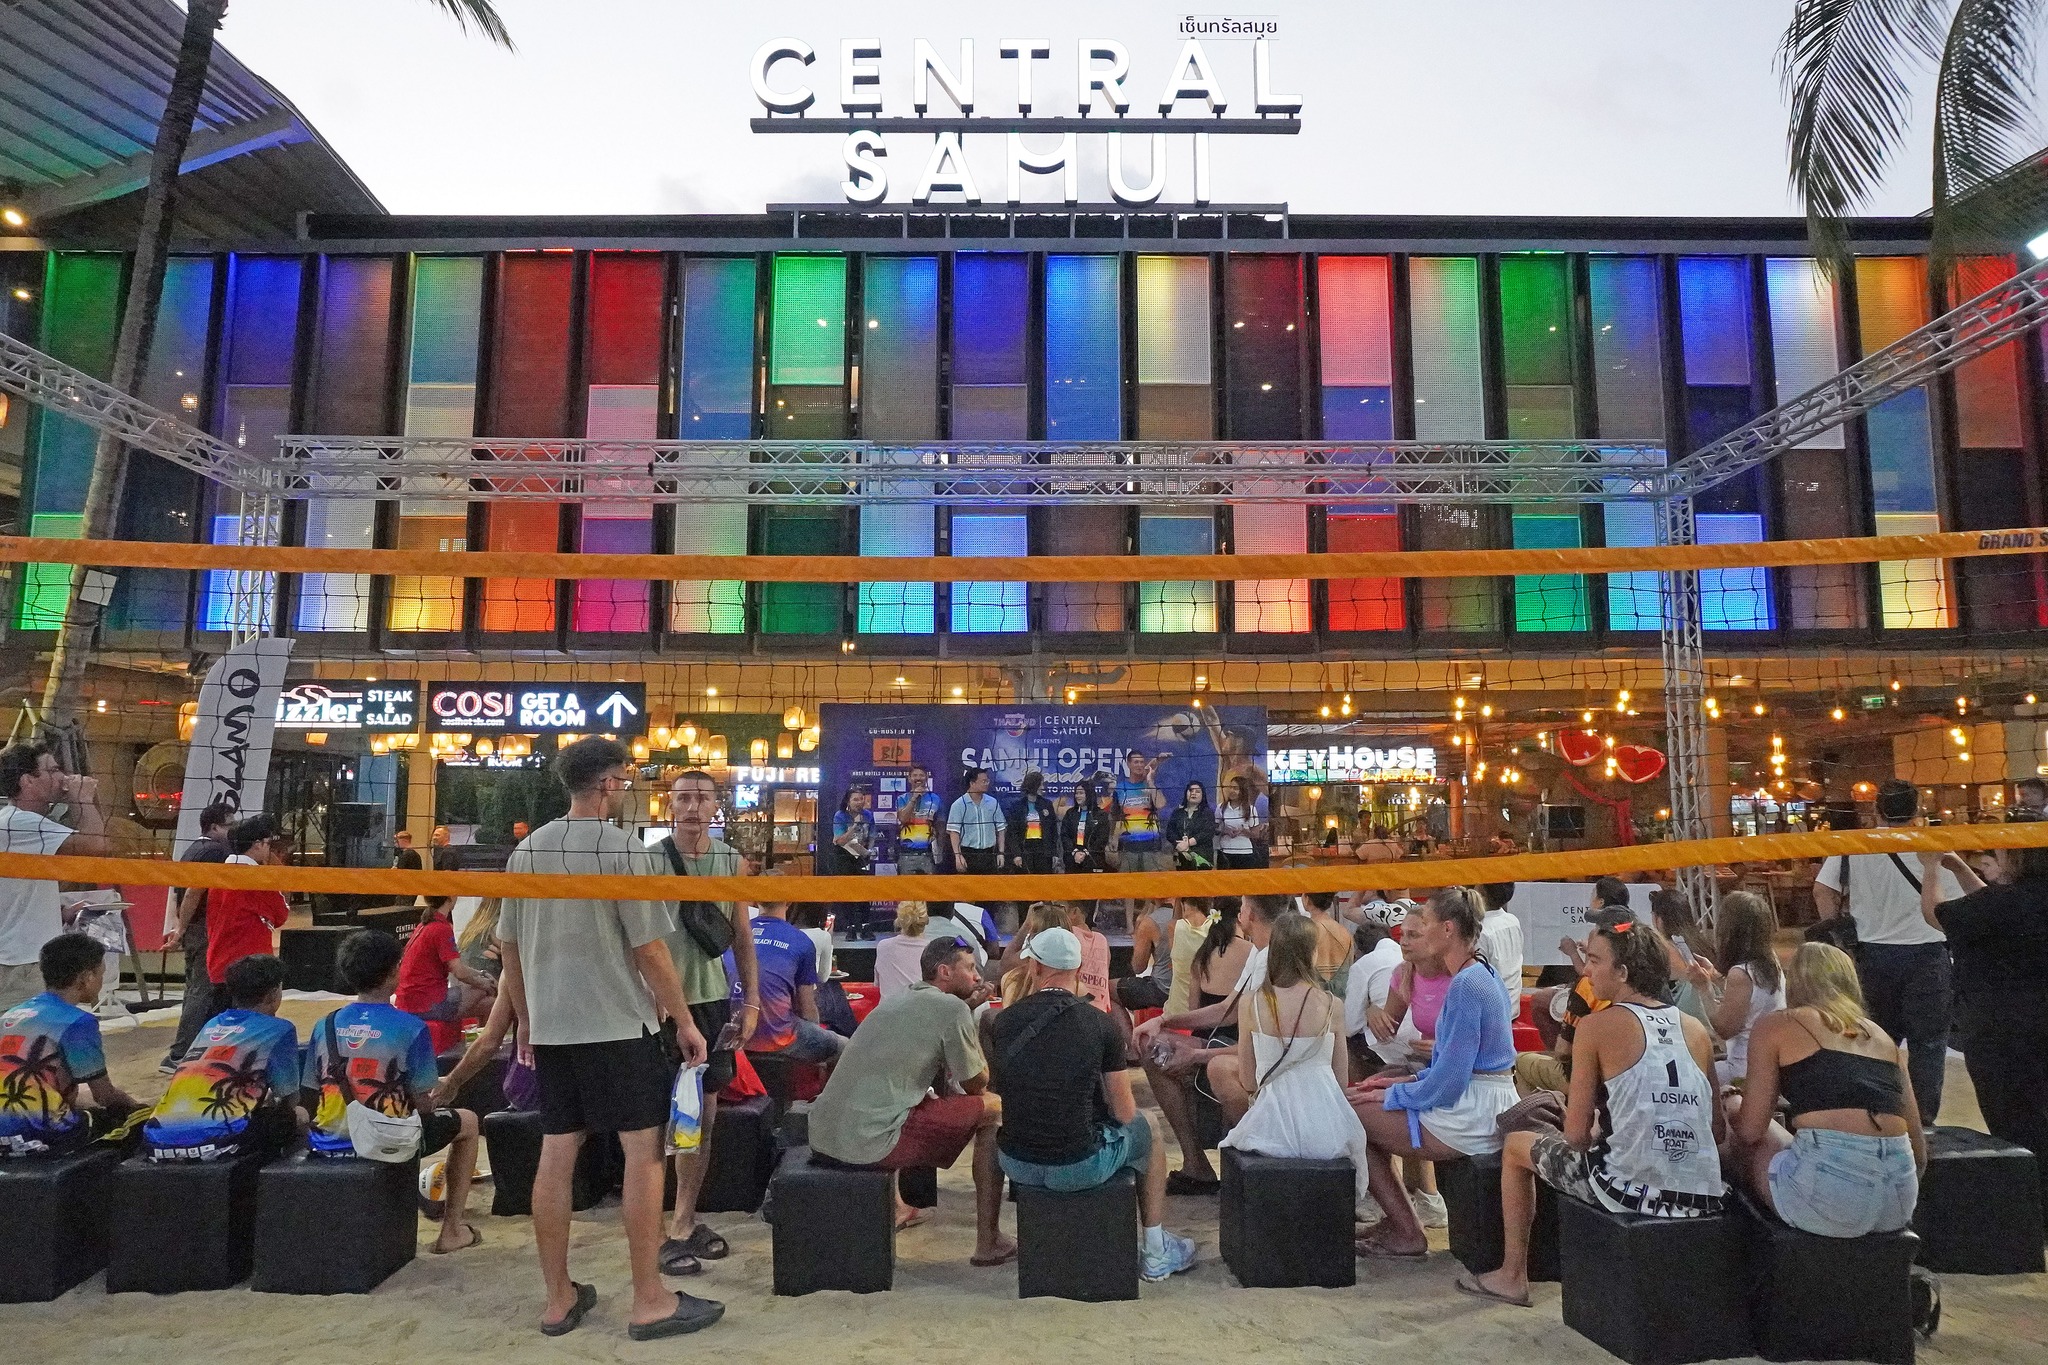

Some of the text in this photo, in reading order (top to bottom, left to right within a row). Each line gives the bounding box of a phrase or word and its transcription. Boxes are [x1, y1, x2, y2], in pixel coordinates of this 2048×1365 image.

[1179, 15, 1277, 39] เซ็นทรัลสมุย
[749, 37, 1303, 114] CENTRAL
[840, 129, 1211, 208] SAMUI
[1978, 533, 2034, 549] GRAND
[367, 690, 413, 702] STEAK
[432, 691, 513, 717] COSI
[520, 692, 580, 710] GET A
[275, 697, 363, 723] izzler
[384, 702, 395, 714] &
[366, 713, 412, 726] SALAD
[519, 709, 586, 727] ROOM
[1044, 715, 1101, 725] CENTRAL
[1052, 726, 1092, 735] SAMUI
[961, 746, 1132, 778] SAMUI OPEN
[737, 766, 787, 782] FUJI
[1562, 906, 1590, 914] CENT
[772, 940, 790, 950] TOUR
[1665, 1059, 1680, 1088] 1
[1651, 1092, 1699, 1107] LOSIAK
